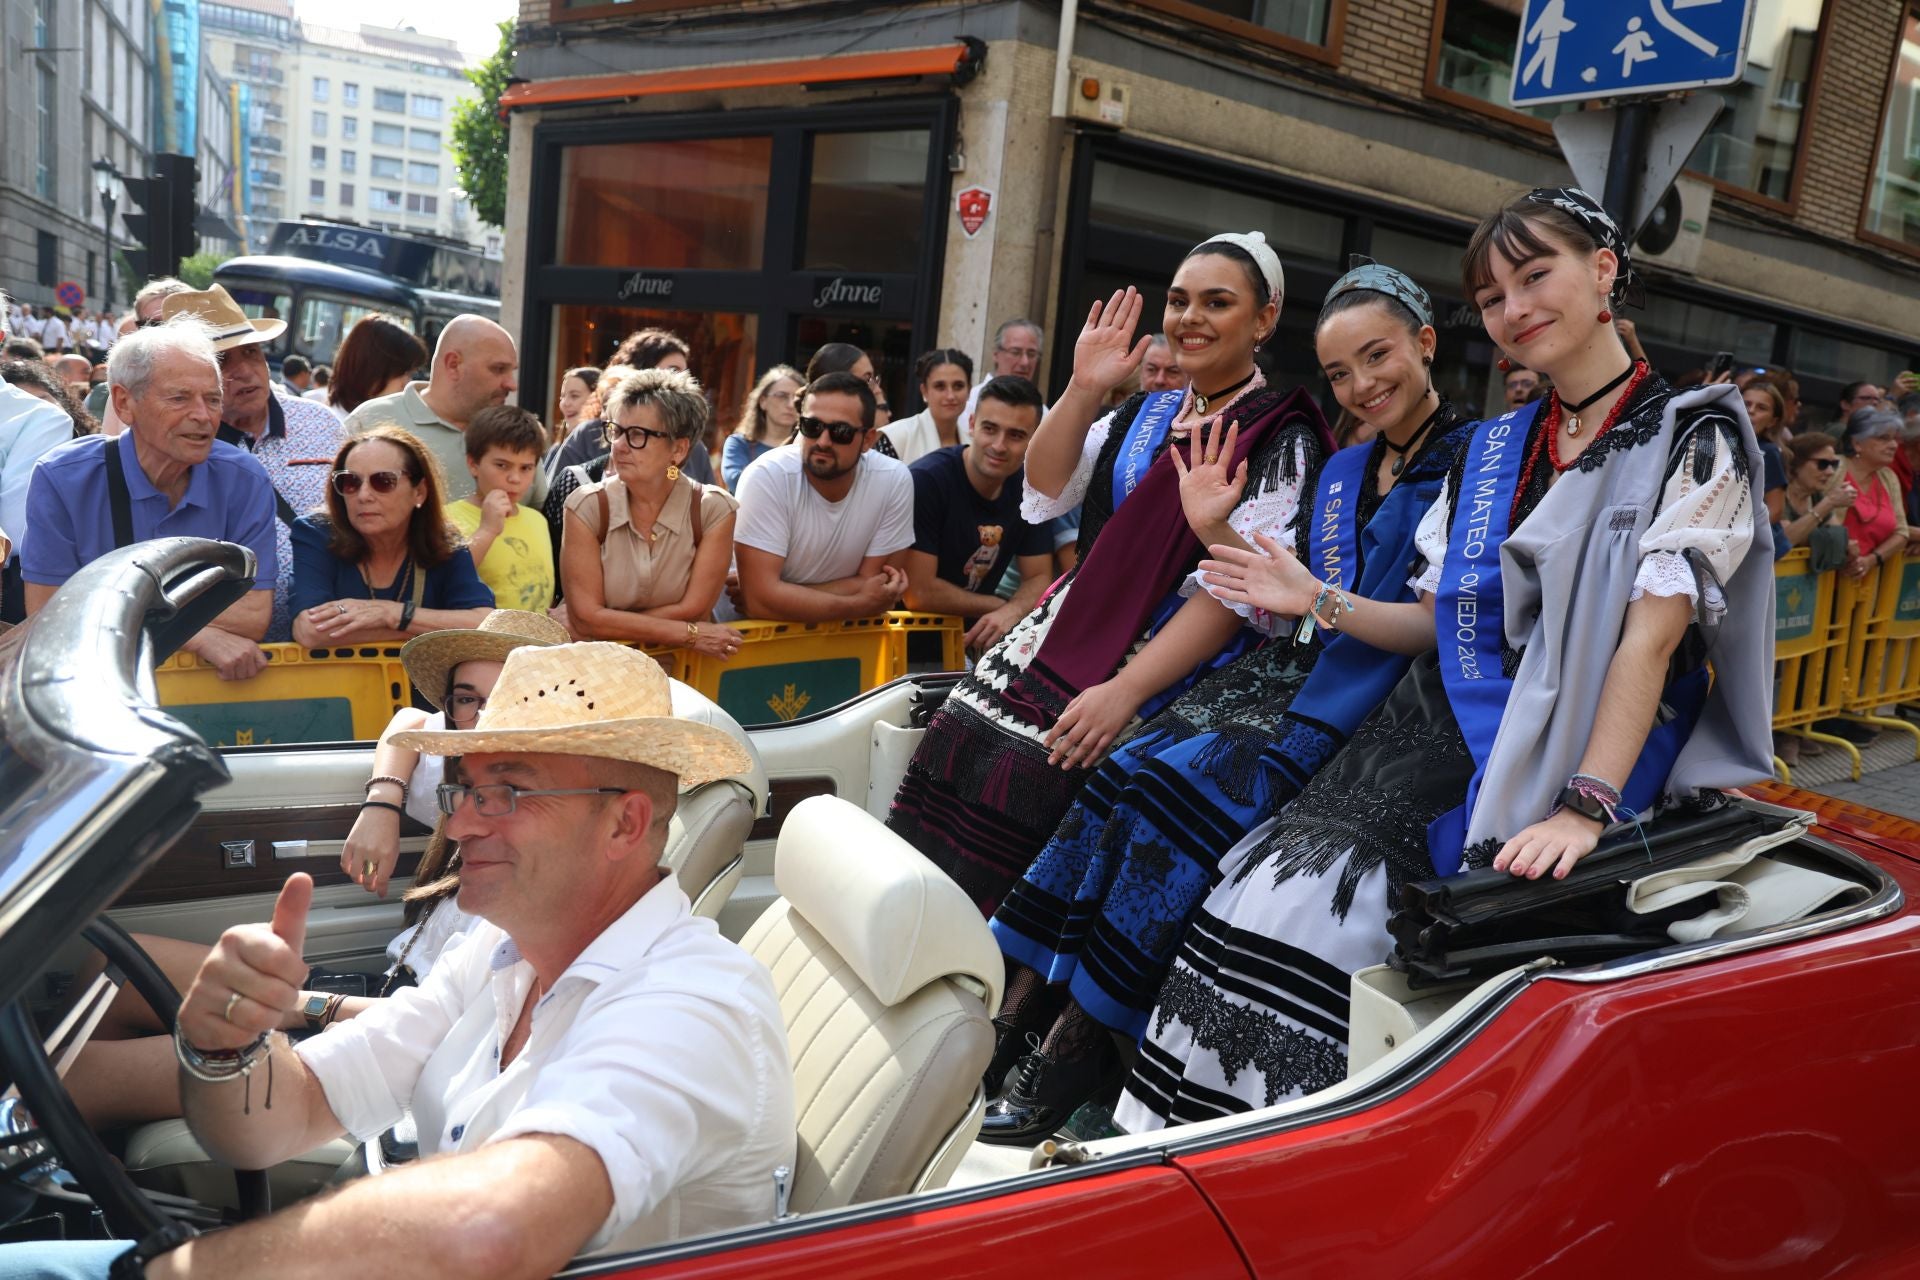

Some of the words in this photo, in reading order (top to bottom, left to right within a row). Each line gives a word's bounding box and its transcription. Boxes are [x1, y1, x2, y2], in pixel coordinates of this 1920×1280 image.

[286, 226, 385, 259] ALSA
[618, 271, 674, 300] Anne
[813, 277, 882, 309] Anne
[1149, 393, 1179, 413] SAN
[1128, 415, 1163, 457] MATEO
[1480, 424, 1511, 473] SAN
[1124, 462, 1138, 497] OVIE
[1321, 498, 1343, 543] SAN
[1463, 477, 1498, 559] MATEO
[1321, 545, 1342, 590] MAT
[1456, 573, 1480, 643] OVIEDO
